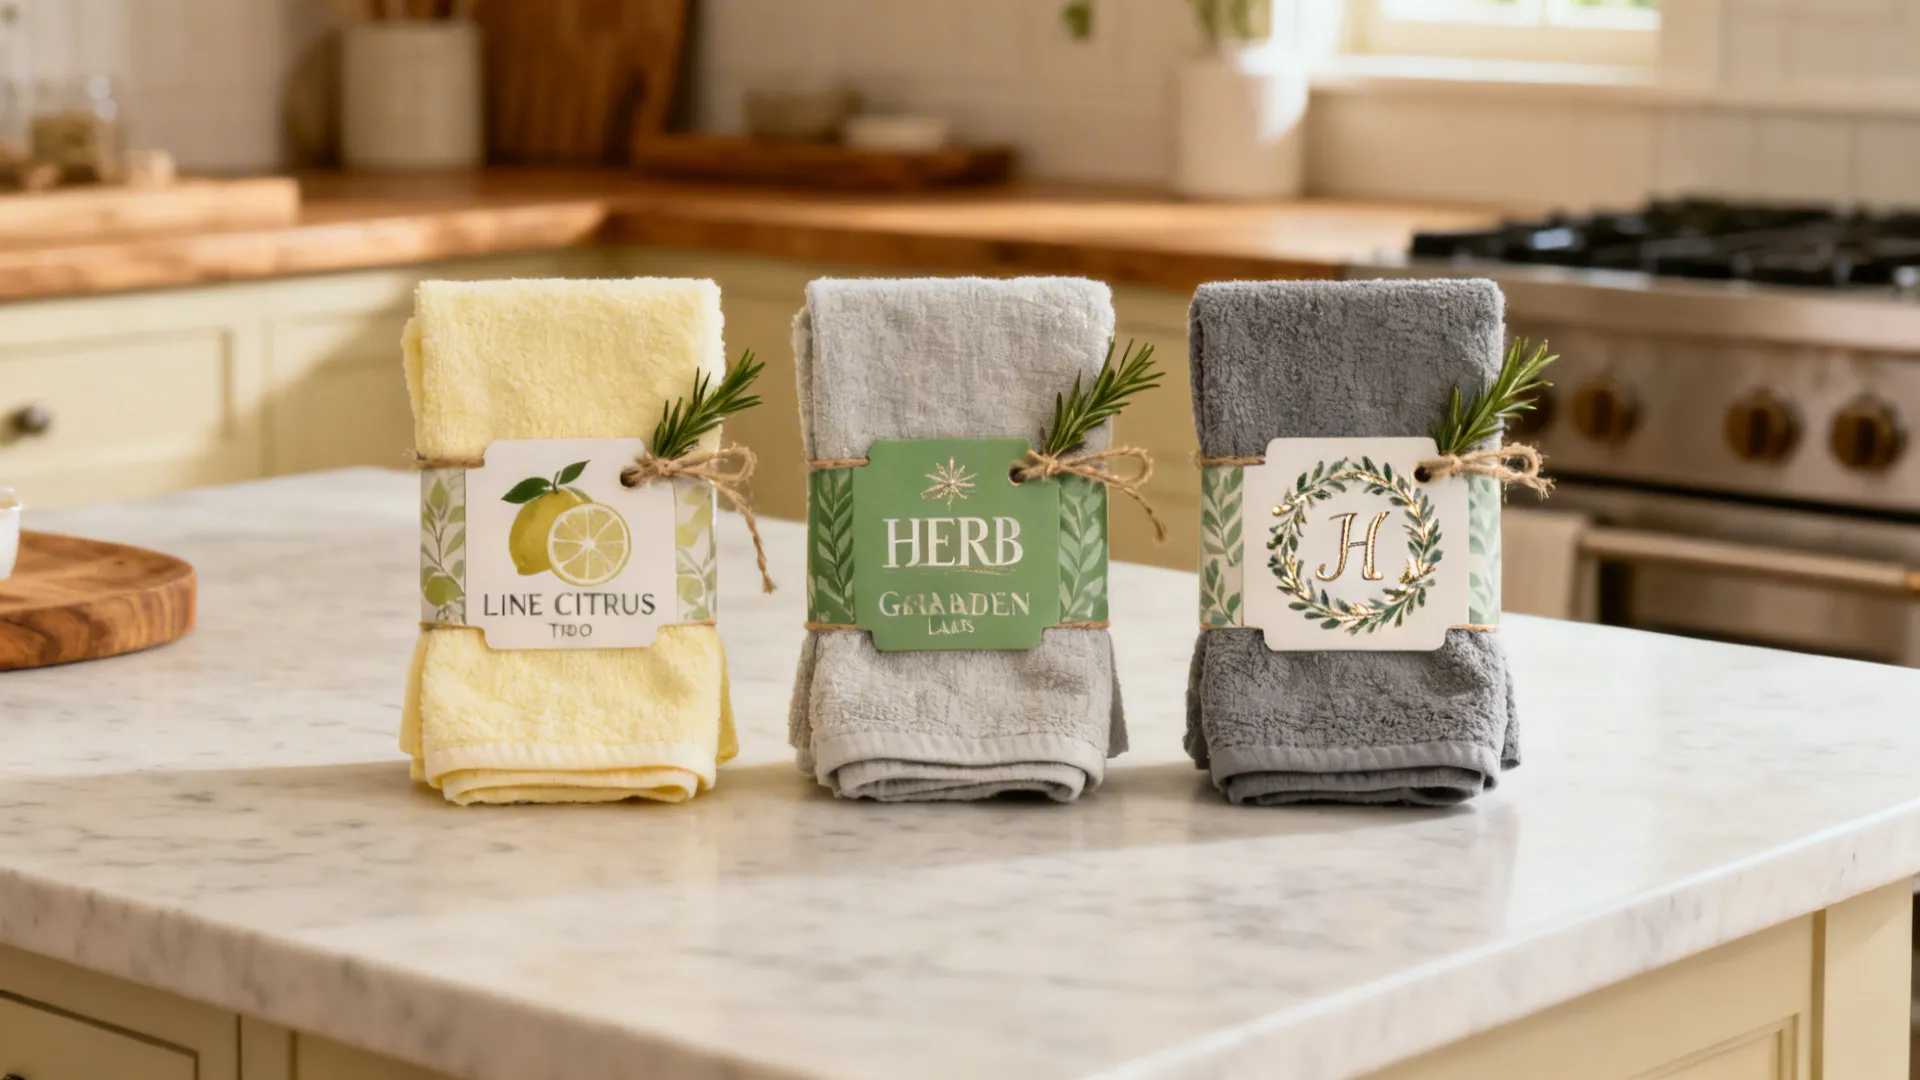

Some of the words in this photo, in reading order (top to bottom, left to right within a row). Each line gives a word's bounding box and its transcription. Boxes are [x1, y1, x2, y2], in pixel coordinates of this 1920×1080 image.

[882, 516, 1024, 568] HERB
[1316, 511, 1390, 582] H
[484, 592, 543, 616] LINE
[553, 591, 656, 616] CITRUS
